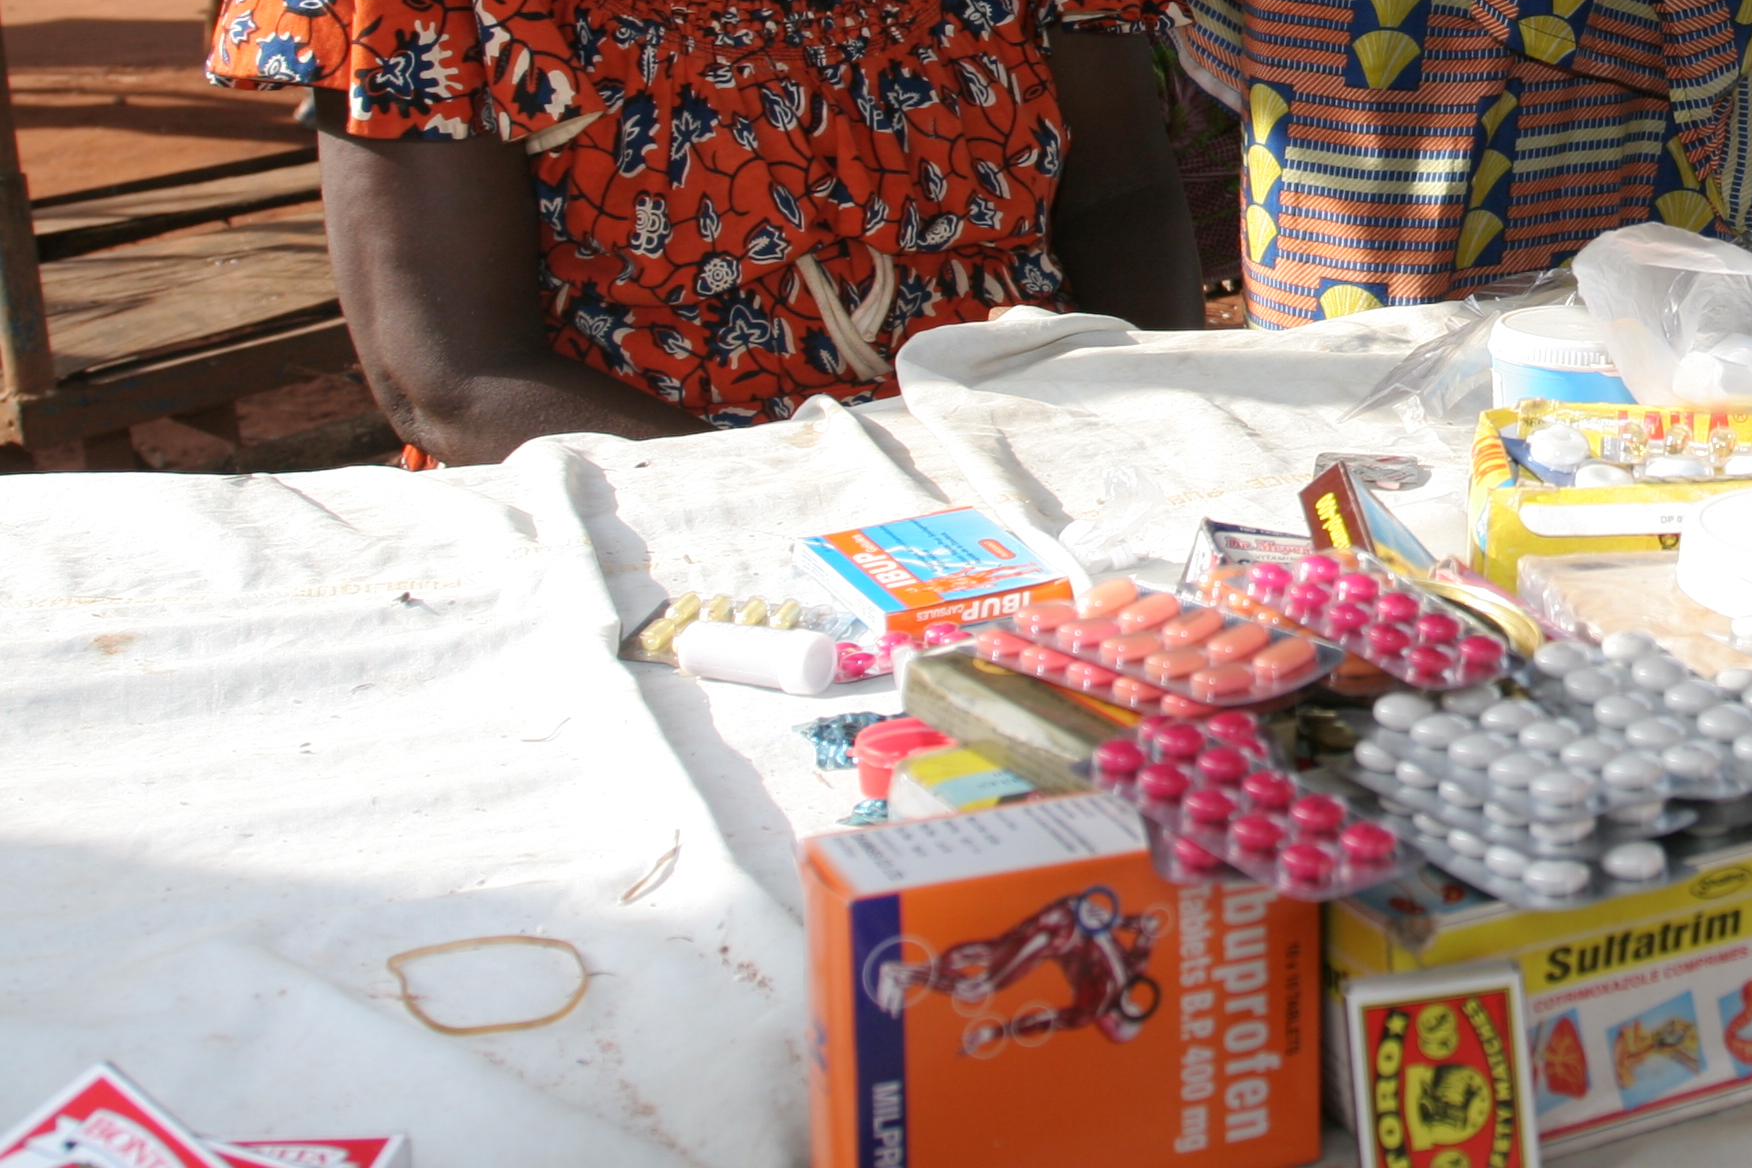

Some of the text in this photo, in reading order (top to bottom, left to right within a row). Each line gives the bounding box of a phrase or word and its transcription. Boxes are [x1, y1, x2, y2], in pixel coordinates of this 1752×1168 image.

[852, 551, 917, 589] IBUP
[1225, 537, 1253, 550] Dr.
[917, 591, 1030, 622] IBUP CAPSULES
[1177, 884, 1213, 988] Tablets
[1545, 909, 1743, 983] Sulfatrim
[1180, 1045, 1215, 1102] 400
[1461, 997, 1513, 1101] MATCHES
[871, 1078, 903, 1168] MILPR
[1174, 1105, 1209, 1154] mg
